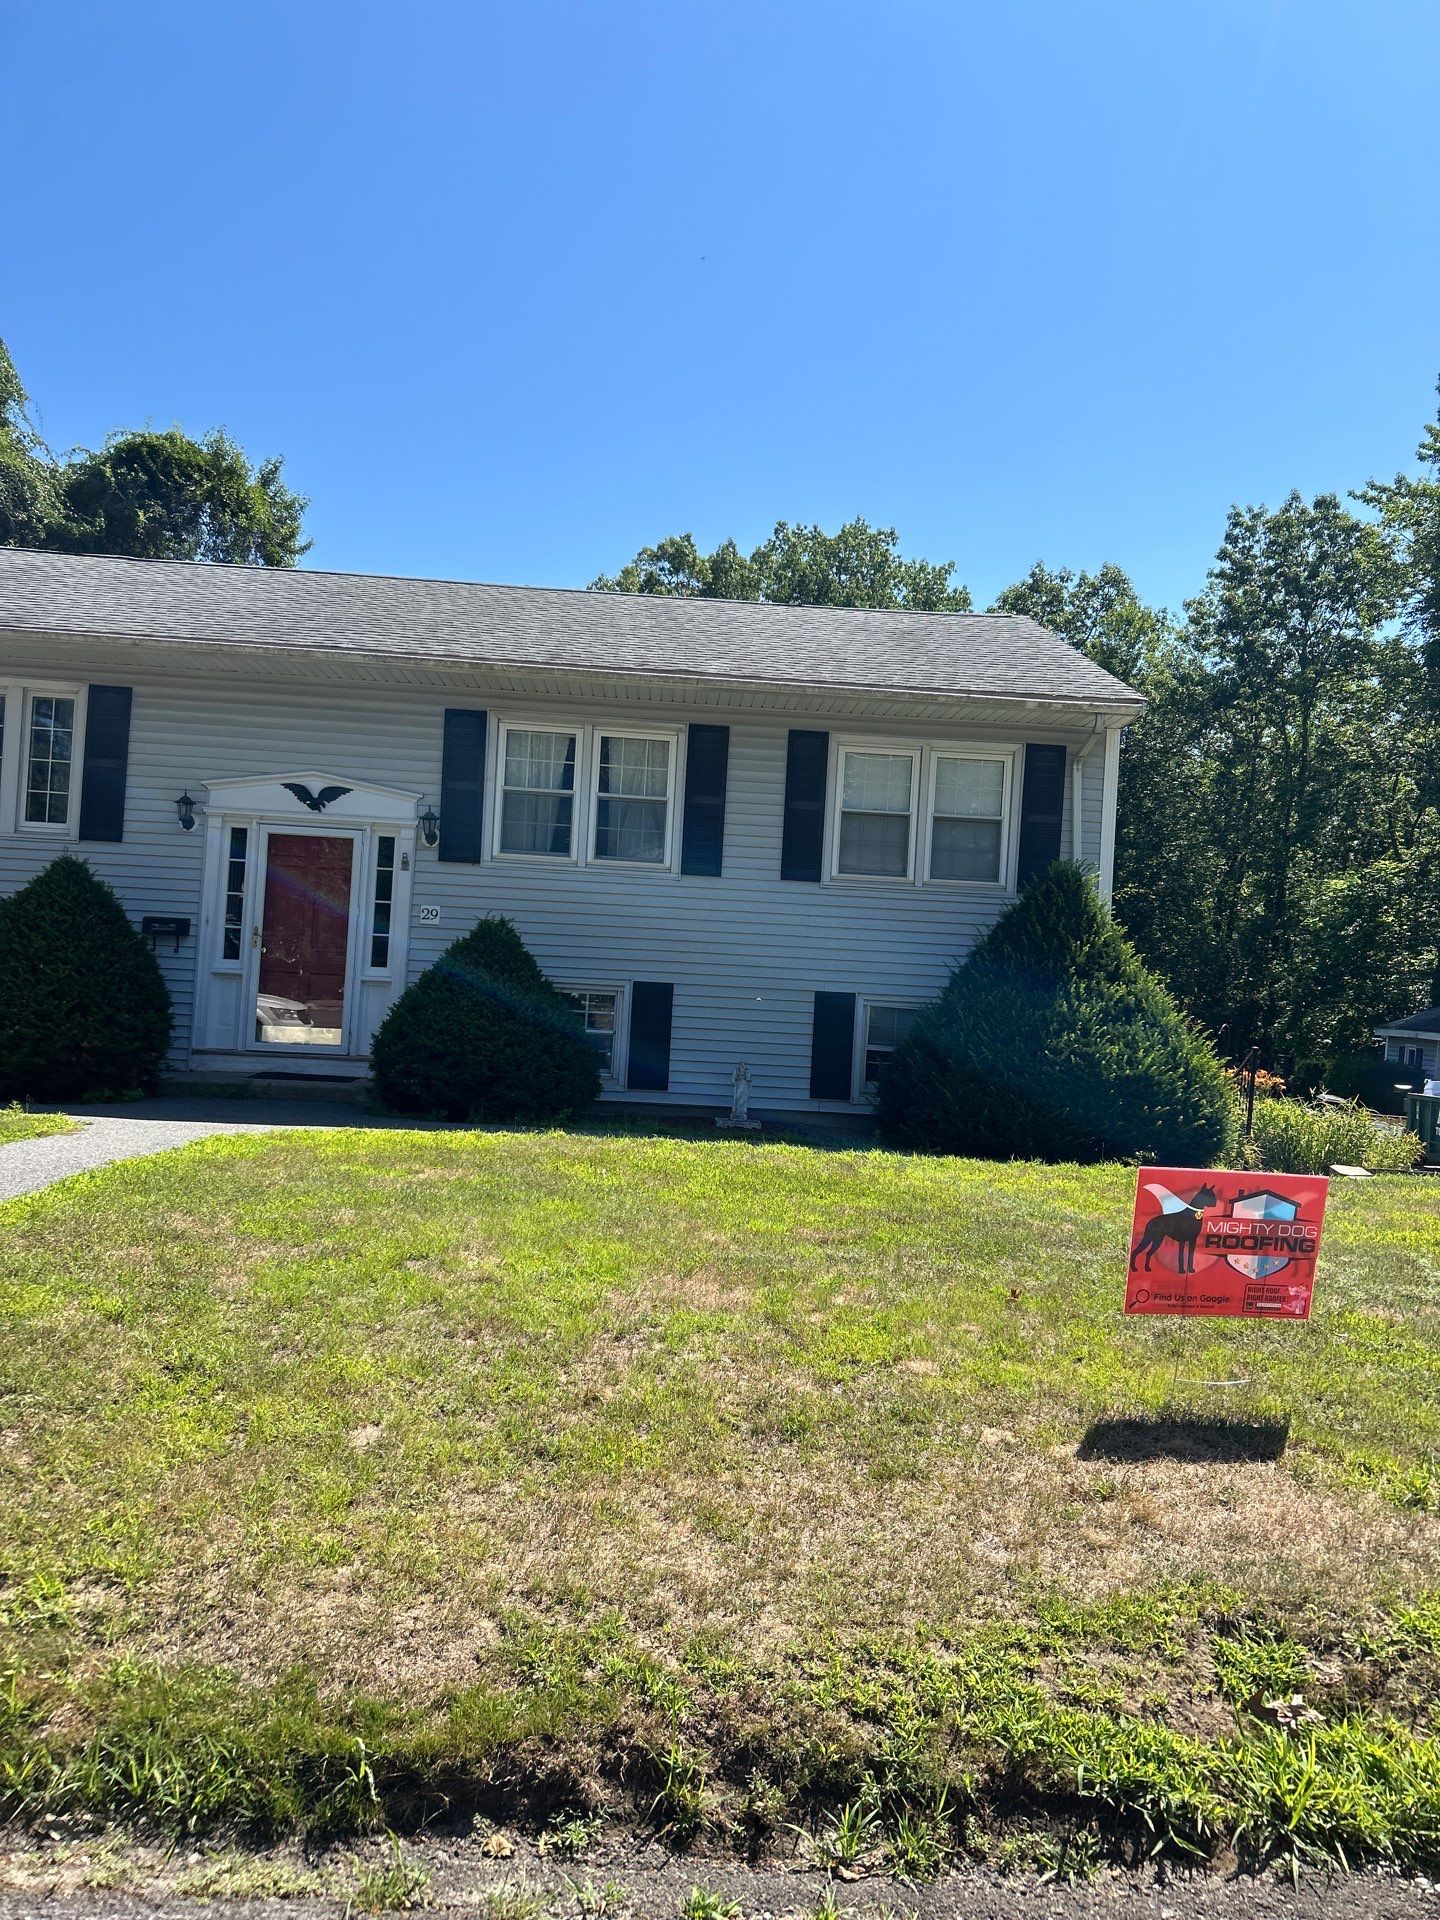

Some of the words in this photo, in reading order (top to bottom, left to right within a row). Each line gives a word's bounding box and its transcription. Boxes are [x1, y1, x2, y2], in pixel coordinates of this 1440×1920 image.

[422, 908, 438, 920] 29
[1207, 1221, 1275, 1235] MIGHTY
[1278, 1224, 1318, 1238] DOG
[1205, 1234, 1316, 1253] ROOFING
[1154, 1293, 1172, 1301] Find
[1175, 1294, 1185, 1302] Us
[1200, 1294, 1230, 1304] Google
